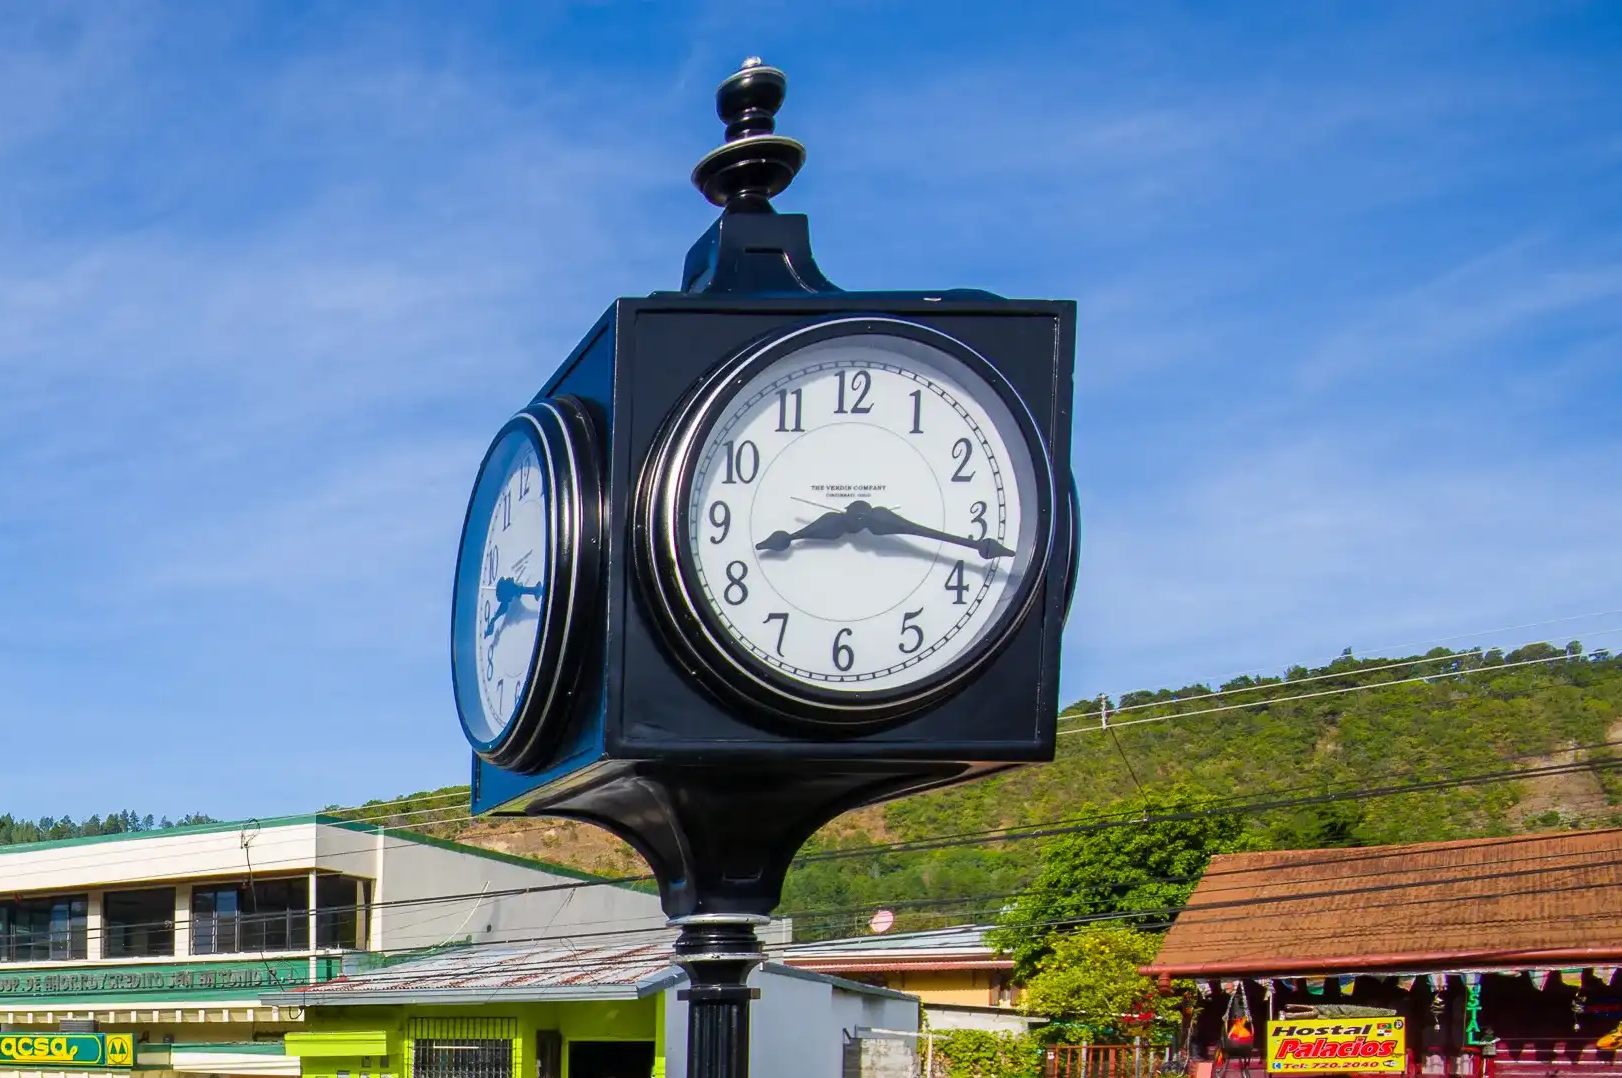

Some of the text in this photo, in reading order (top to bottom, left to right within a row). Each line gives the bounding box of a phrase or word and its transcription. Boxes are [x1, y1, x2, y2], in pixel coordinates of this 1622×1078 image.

[774, 388, 805, 433] 11
[833, 369, 875, 415] 12
[909, 389, 924, 434] 1
[517, 461, 530, 501] 12
[721, 439, 760, 484] 10
[950, 437, 976, 482] 2
[501, 490, 511, 531] 11
[709, 500, 731, 545] 9
[968, 501, 988, 543] 3
[487, 545, 499, 586] 10
[723, 560, 749, 606] 8
[944, 559, 970, 605] 4
[483, 600, 491, 632] 9
[762, 612, 789, 658] 7
[898, 607, 924, 654] 5
[486, 643, 494, 682] 8
[832, 628, 854, 673] 6
[496, 678, 504, 715] 7
[1272, 1024, 1373, 1037] Hostal
[1275, 1037, 1398, 1060] Palacios
